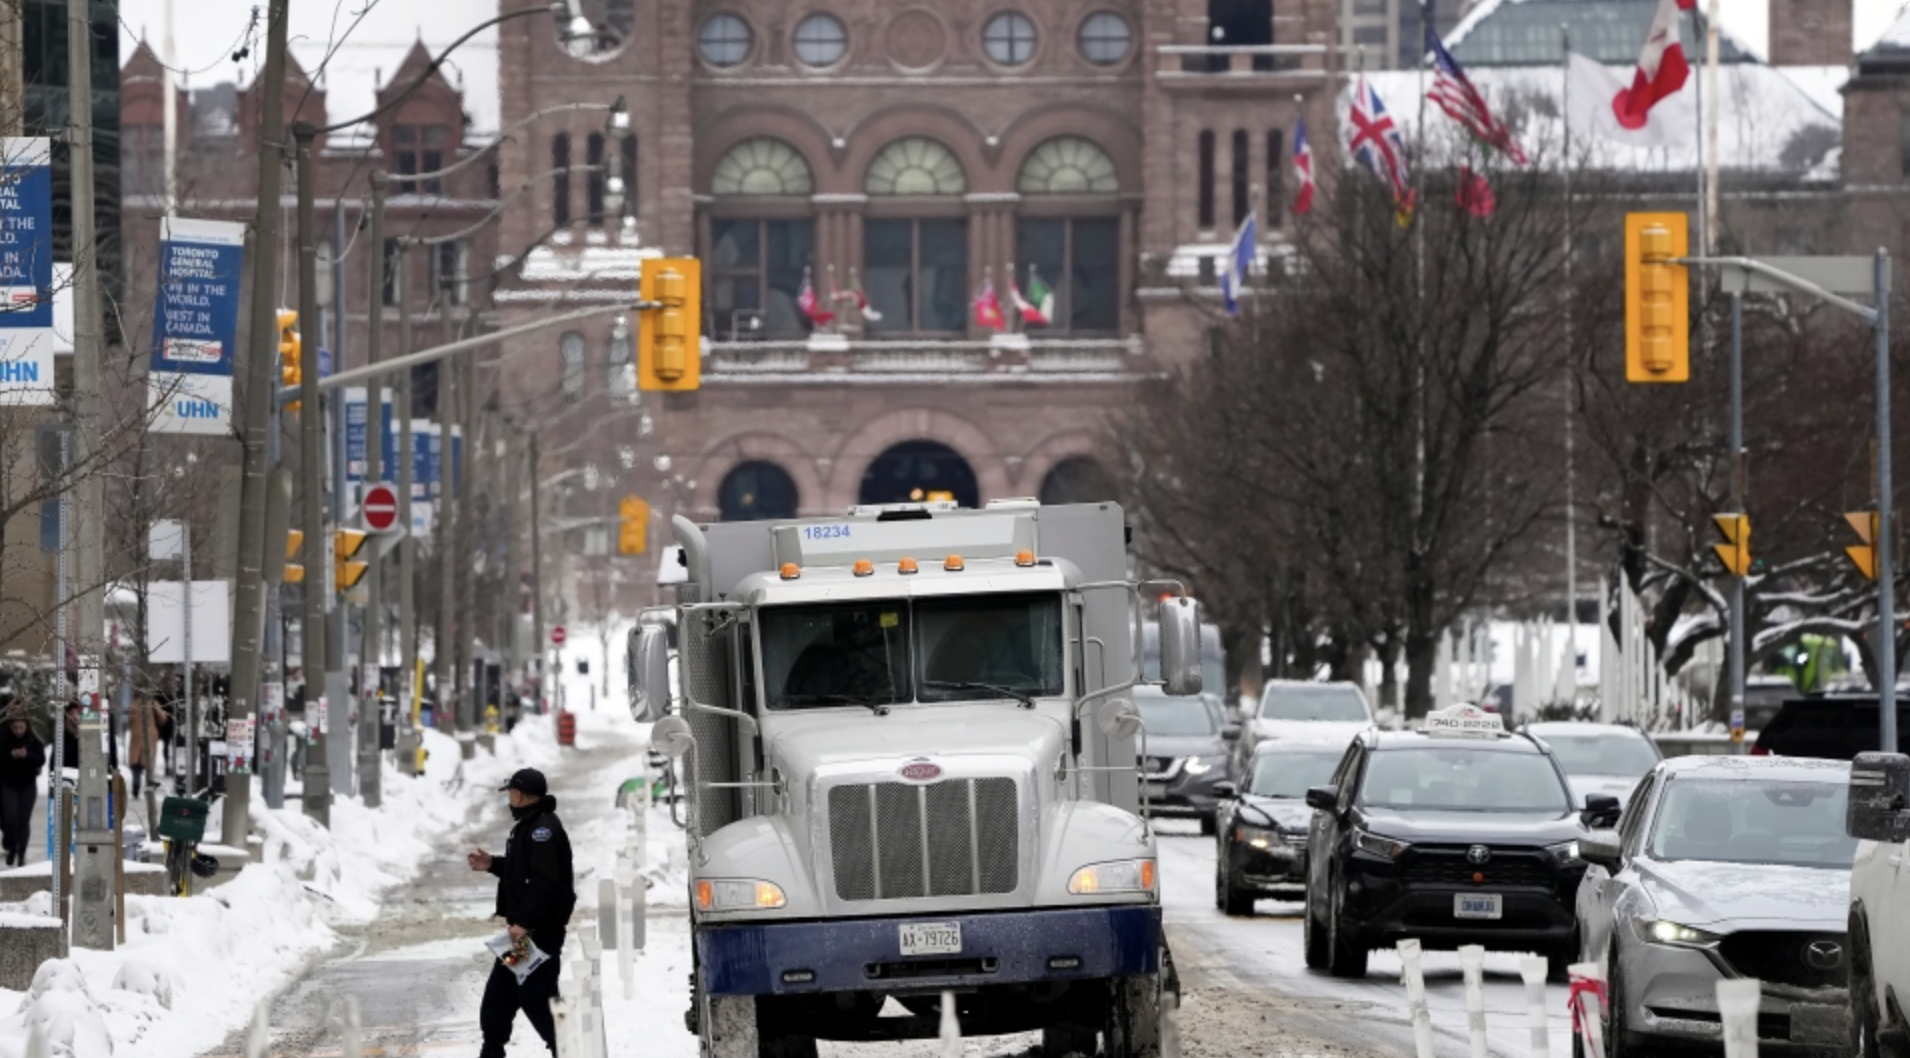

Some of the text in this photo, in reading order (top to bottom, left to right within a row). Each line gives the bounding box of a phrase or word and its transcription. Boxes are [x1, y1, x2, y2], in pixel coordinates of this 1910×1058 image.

[8, 217, 35, 230] THE
[4, 252, 19, 264] IN
[172, 247, 219, 259] TORONTO
[170, 257, 214, 270] GENERAL
[170, 267, 216, 279] HOSPITAL
[187, 283, 199, 293] IN
[204, 285, 226, 296] THE
[165, 309, 211, 322] BEST IN
[177, 400, 219, 418] UHN
[804, 524, 851, 540] 18234
